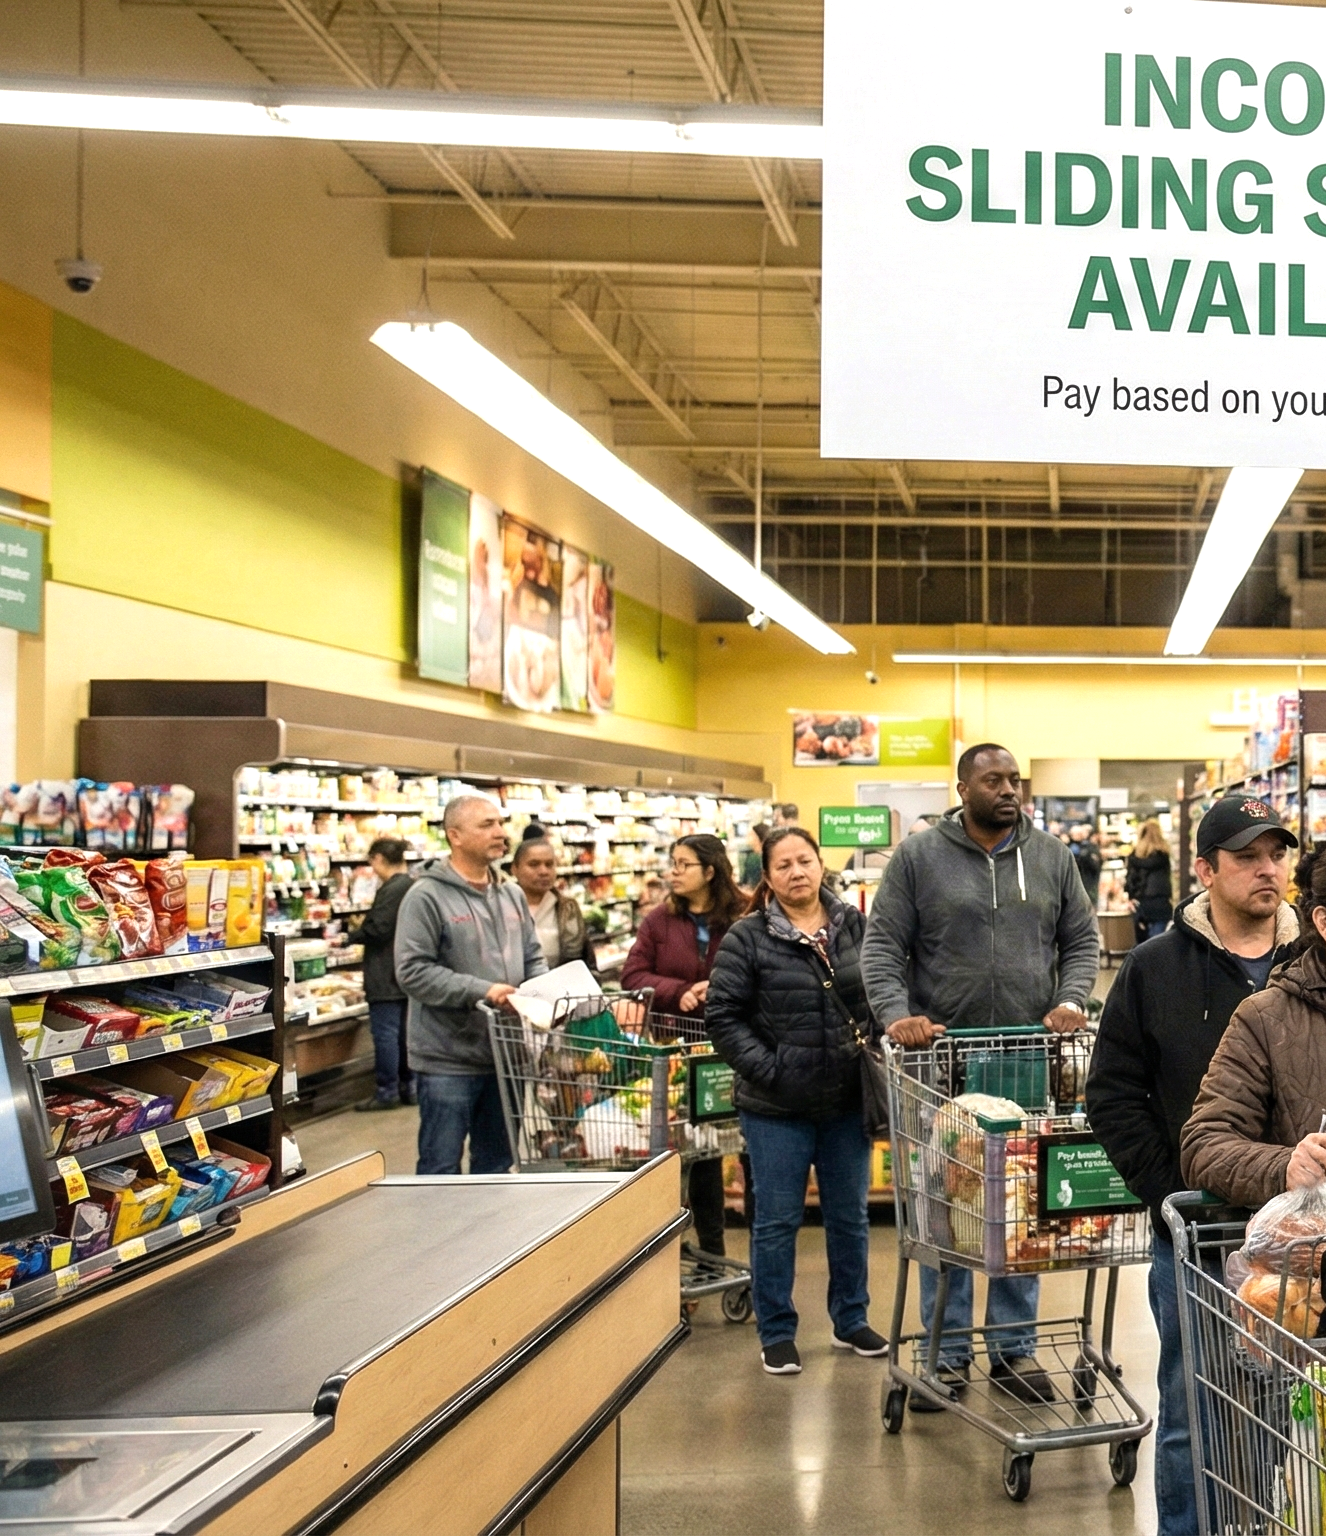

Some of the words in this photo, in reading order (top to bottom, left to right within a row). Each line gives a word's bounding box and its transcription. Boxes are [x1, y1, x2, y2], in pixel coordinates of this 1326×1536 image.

[905, 144, 1274, 235] SLIDING
[1043, 375, 1101, 418] Pay
[1113, 376, 1209, 413] based
[1221, 389, 1260, 415] on
